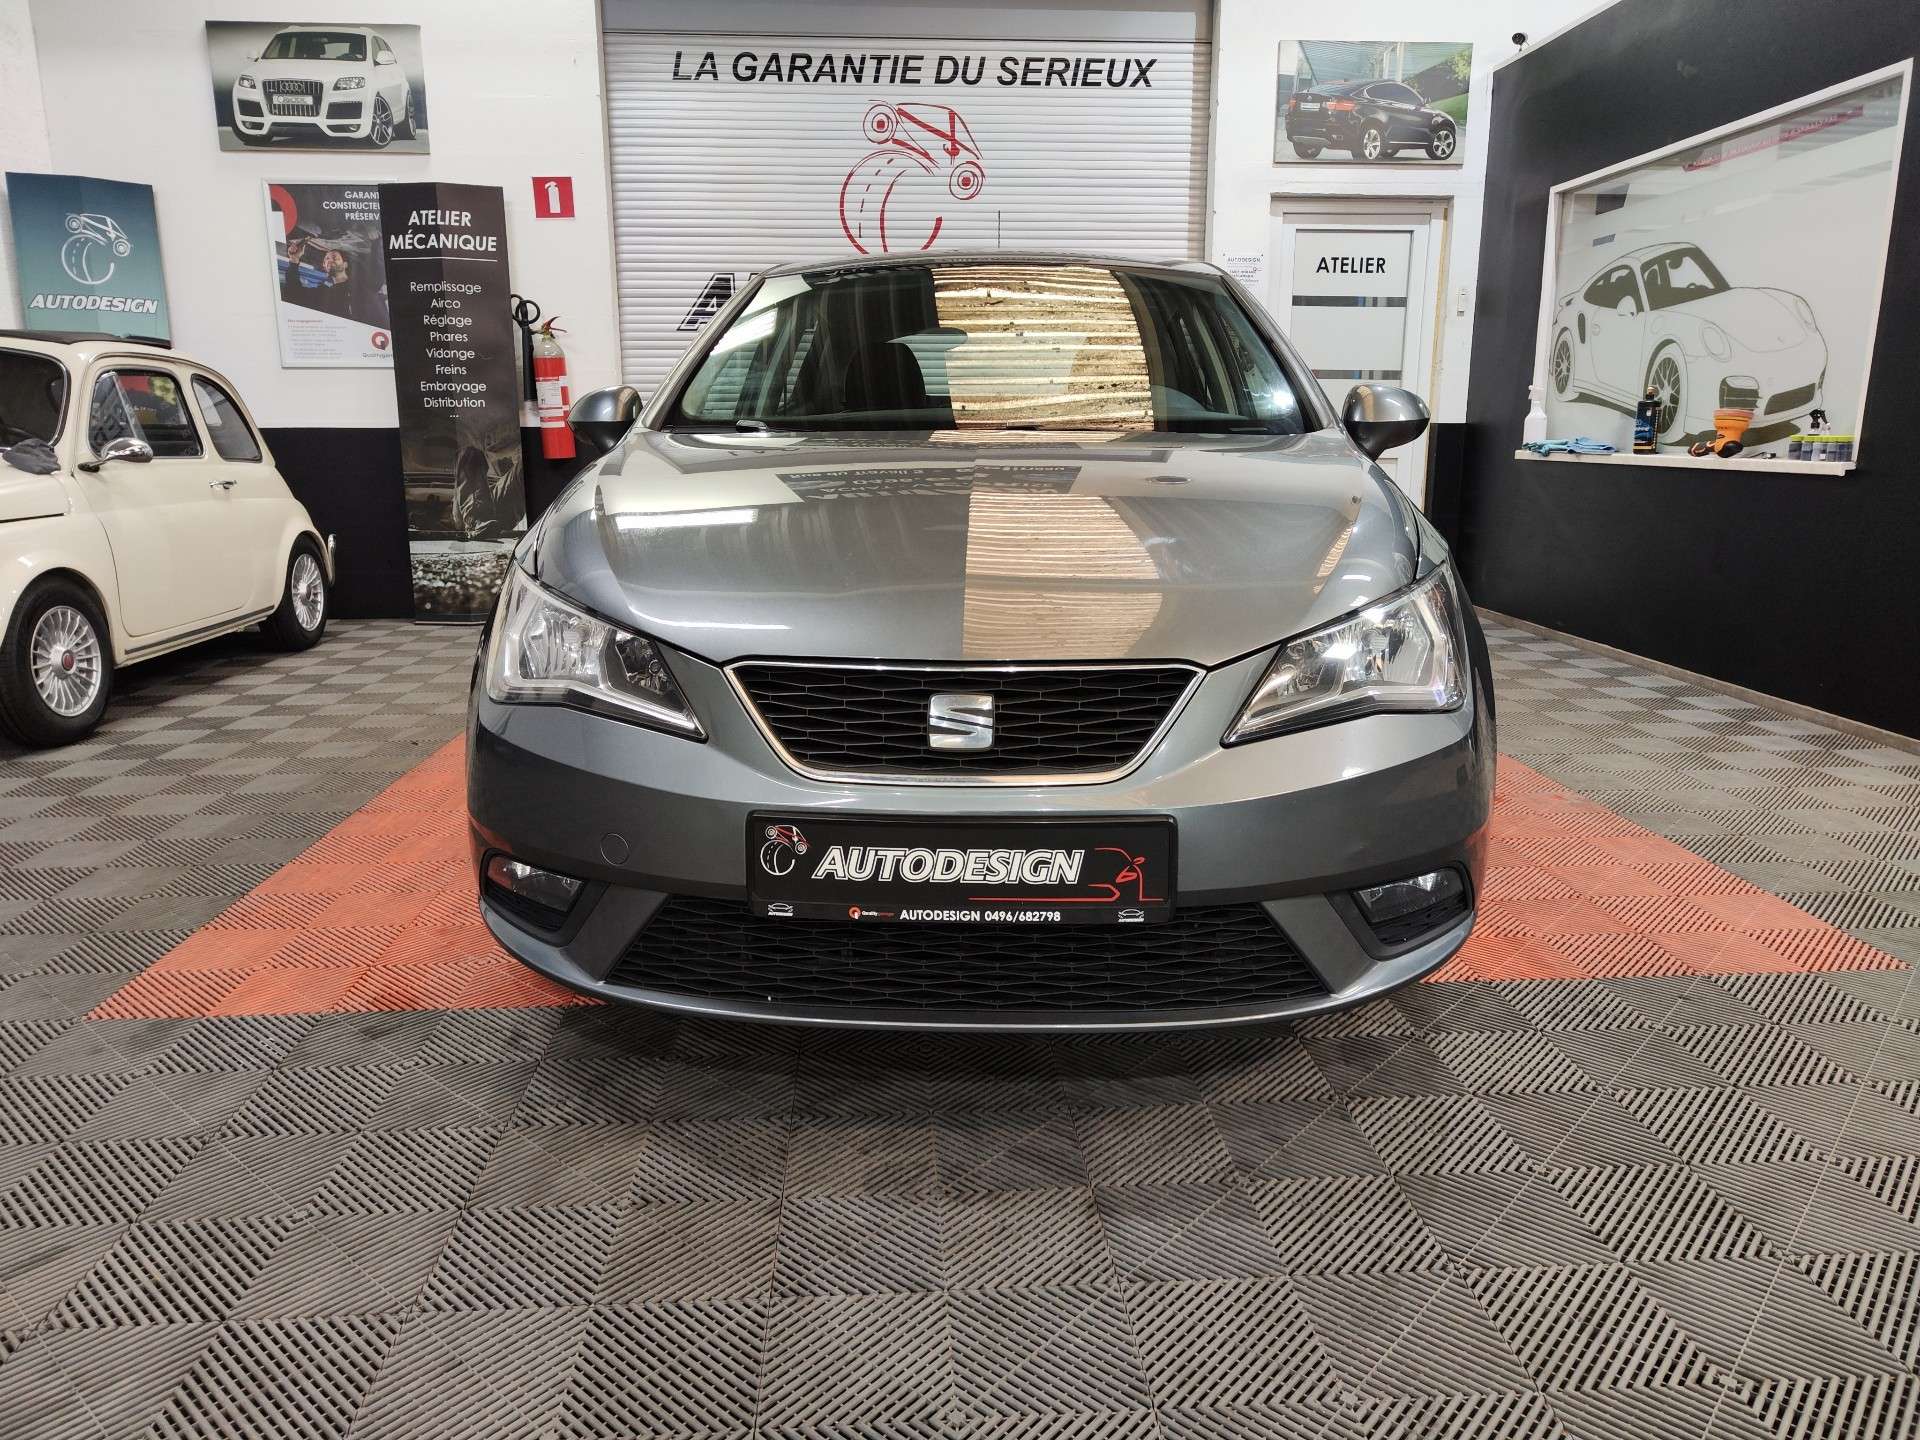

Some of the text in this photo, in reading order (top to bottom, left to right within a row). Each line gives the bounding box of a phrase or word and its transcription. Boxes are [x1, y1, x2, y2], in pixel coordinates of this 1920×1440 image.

[672, 51, 1157, 88] LA GARANTIE DU SERIEUX
[408, 209, 472, 227] ATELIER
[389, 229, 497, 252] MÉCANIQUE
[1316, 256, 1386, 274] ATELIER
[410, 281, 482, 295] Remplissage
[29, 294, 159, 314] AUTODESIGN
[430, 298, 461, 309] Airco
[423, 314, 473, 328] Réglage
[430, 331, 469, 342] Phares
[425, 348, 475, 361] Vidange
[435, 364, 467, 375] Freins
[420, 381, 487, 394] Embrayage
[423, 397, 486, 408] Distribution
[811, 846, 1085, 885] AUTODESIGN
[900, 909, 981, 922] AUTODESIGN
[984, 910, 1061, 922] 0496/682798
